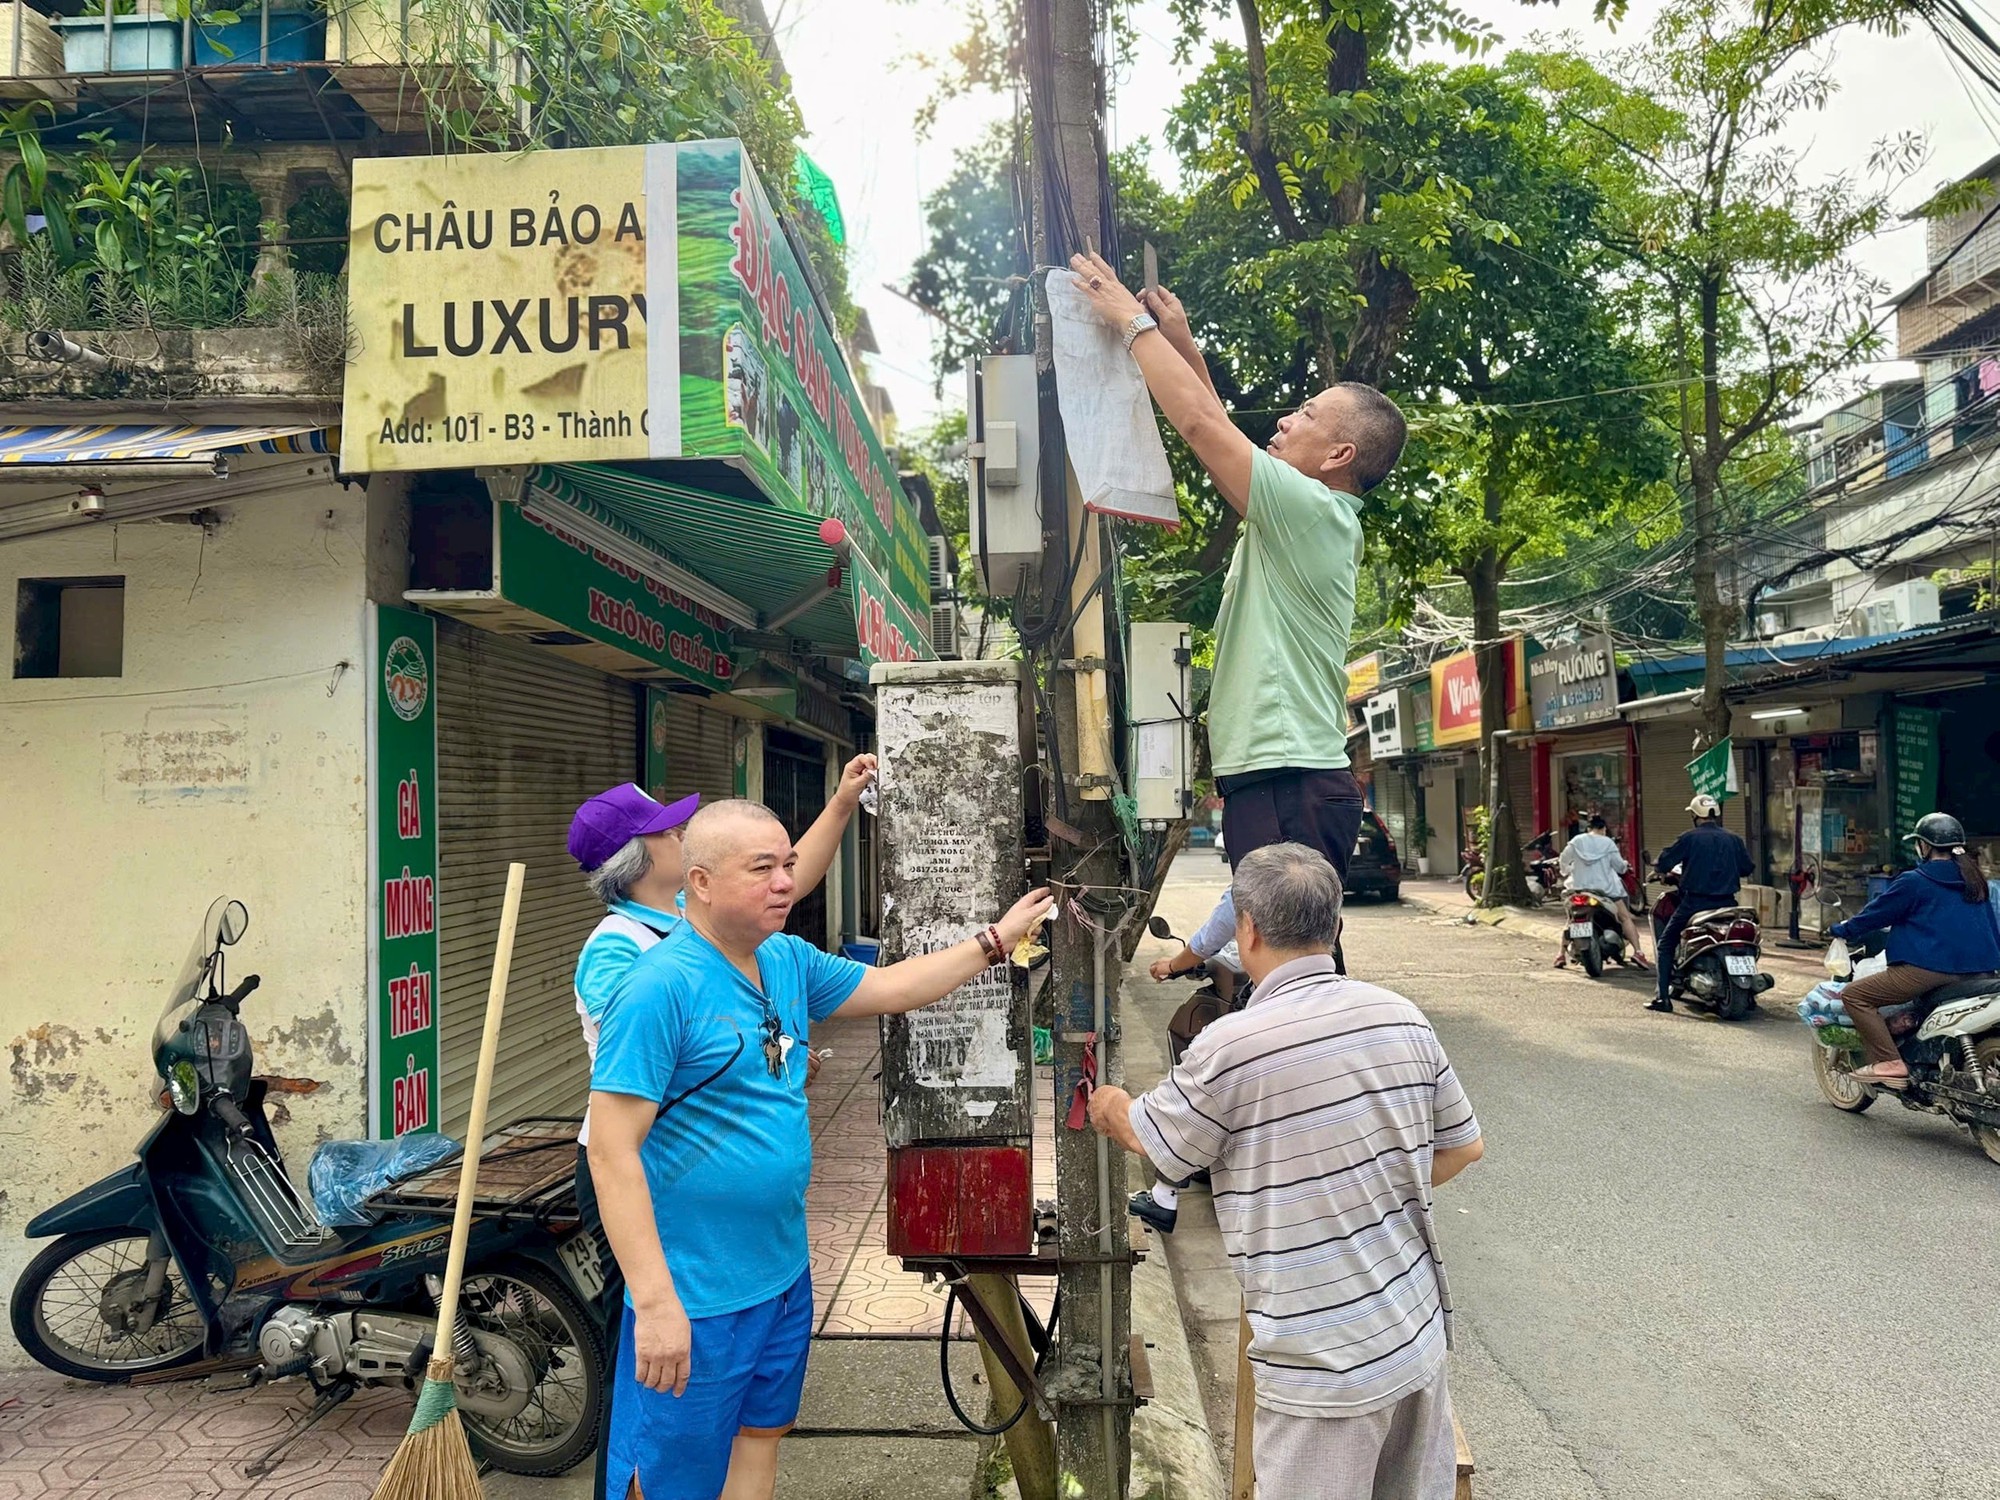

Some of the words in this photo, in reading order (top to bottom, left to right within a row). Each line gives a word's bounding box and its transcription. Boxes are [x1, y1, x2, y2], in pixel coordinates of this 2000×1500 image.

[374, 200, 493, 253] CHÂU
[510, 190, 601, 247] BẢO
[379, 417, 433, 444] Add:
[442, 415, 480, 442] 101
[505, 413, 535, 440] B3
[558, 410, 632, 438] Thành
[588, 587, 665, 652] KHÔNG
[669, 630, 713, 674] CHẤT
[398, 768, 421, 839] GÀ
[385, 866, 434, 939] MÔNG
[389, 962, 431, 1039] TRÊN
[994, 965, 1007, 984] 432
[393, 1053, 428, 1138] BẢN
[379, 1235, 446, 1267] Sirius
